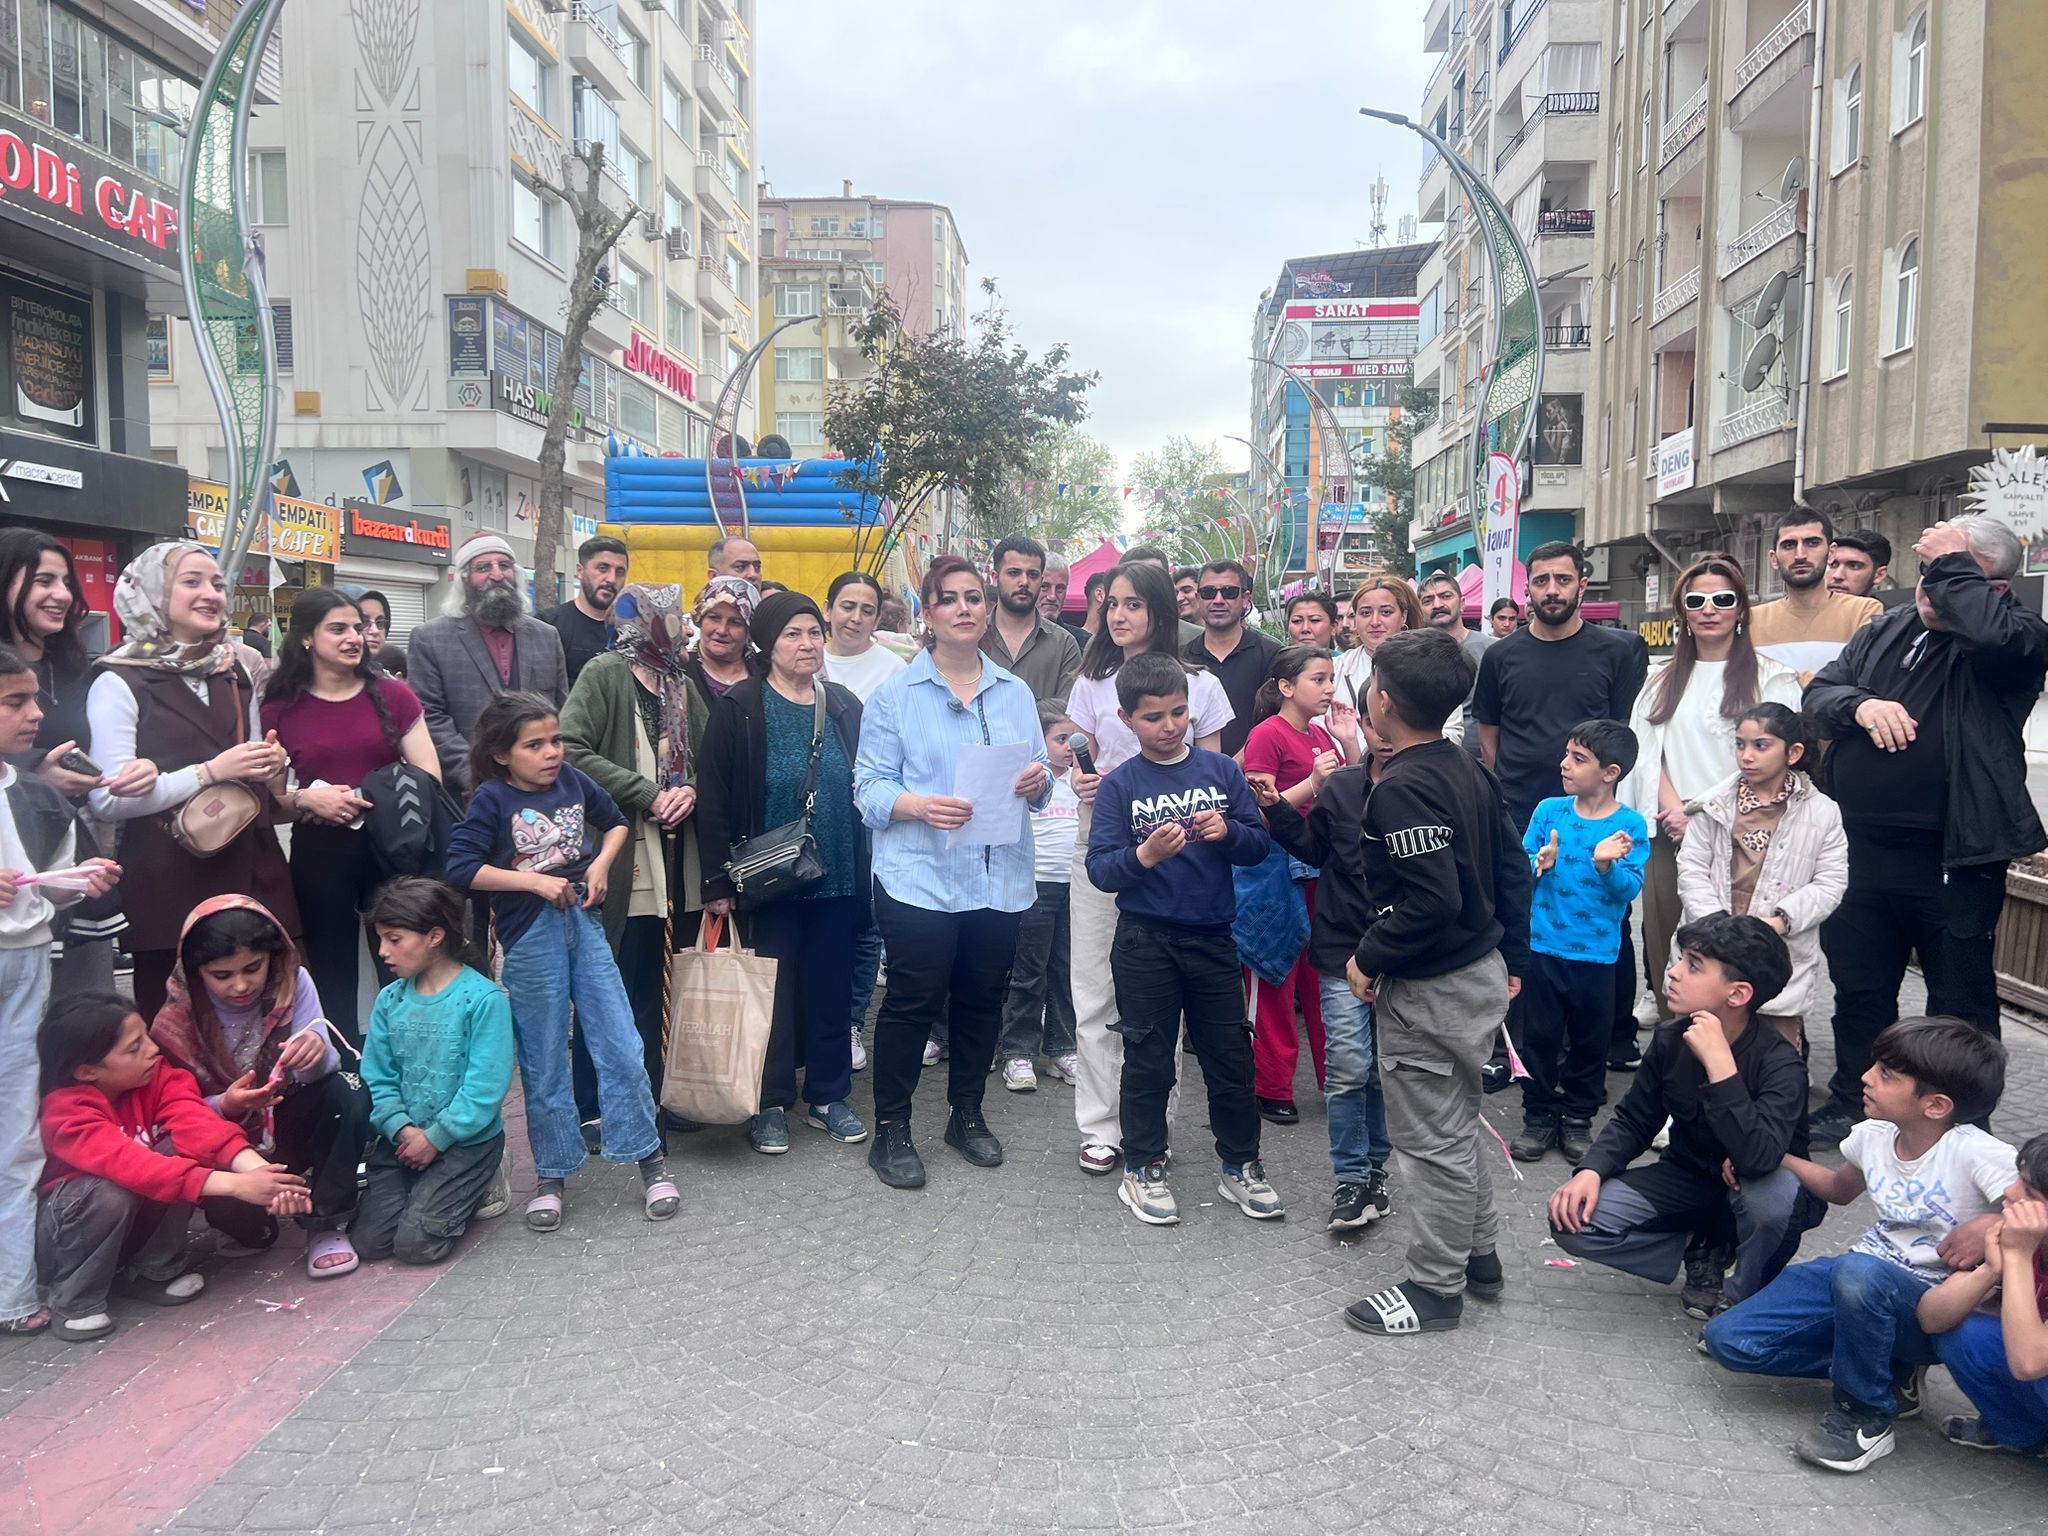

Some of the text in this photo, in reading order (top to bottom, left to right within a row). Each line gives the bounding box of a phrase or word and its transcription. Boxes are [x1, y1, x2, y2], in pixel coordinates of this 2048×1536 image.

[95, 176, 179, 249] CAF
[1315, 305, 1369, 317] SANAT
[1661, 449, 1690, 476] DENG
[1995, 471, 2048, 492] LALE
[196, 516, 225, 538] CAF
[280, 527, 325, 556] CAFE
[1131, 786, 1228, 815] NAVAL
